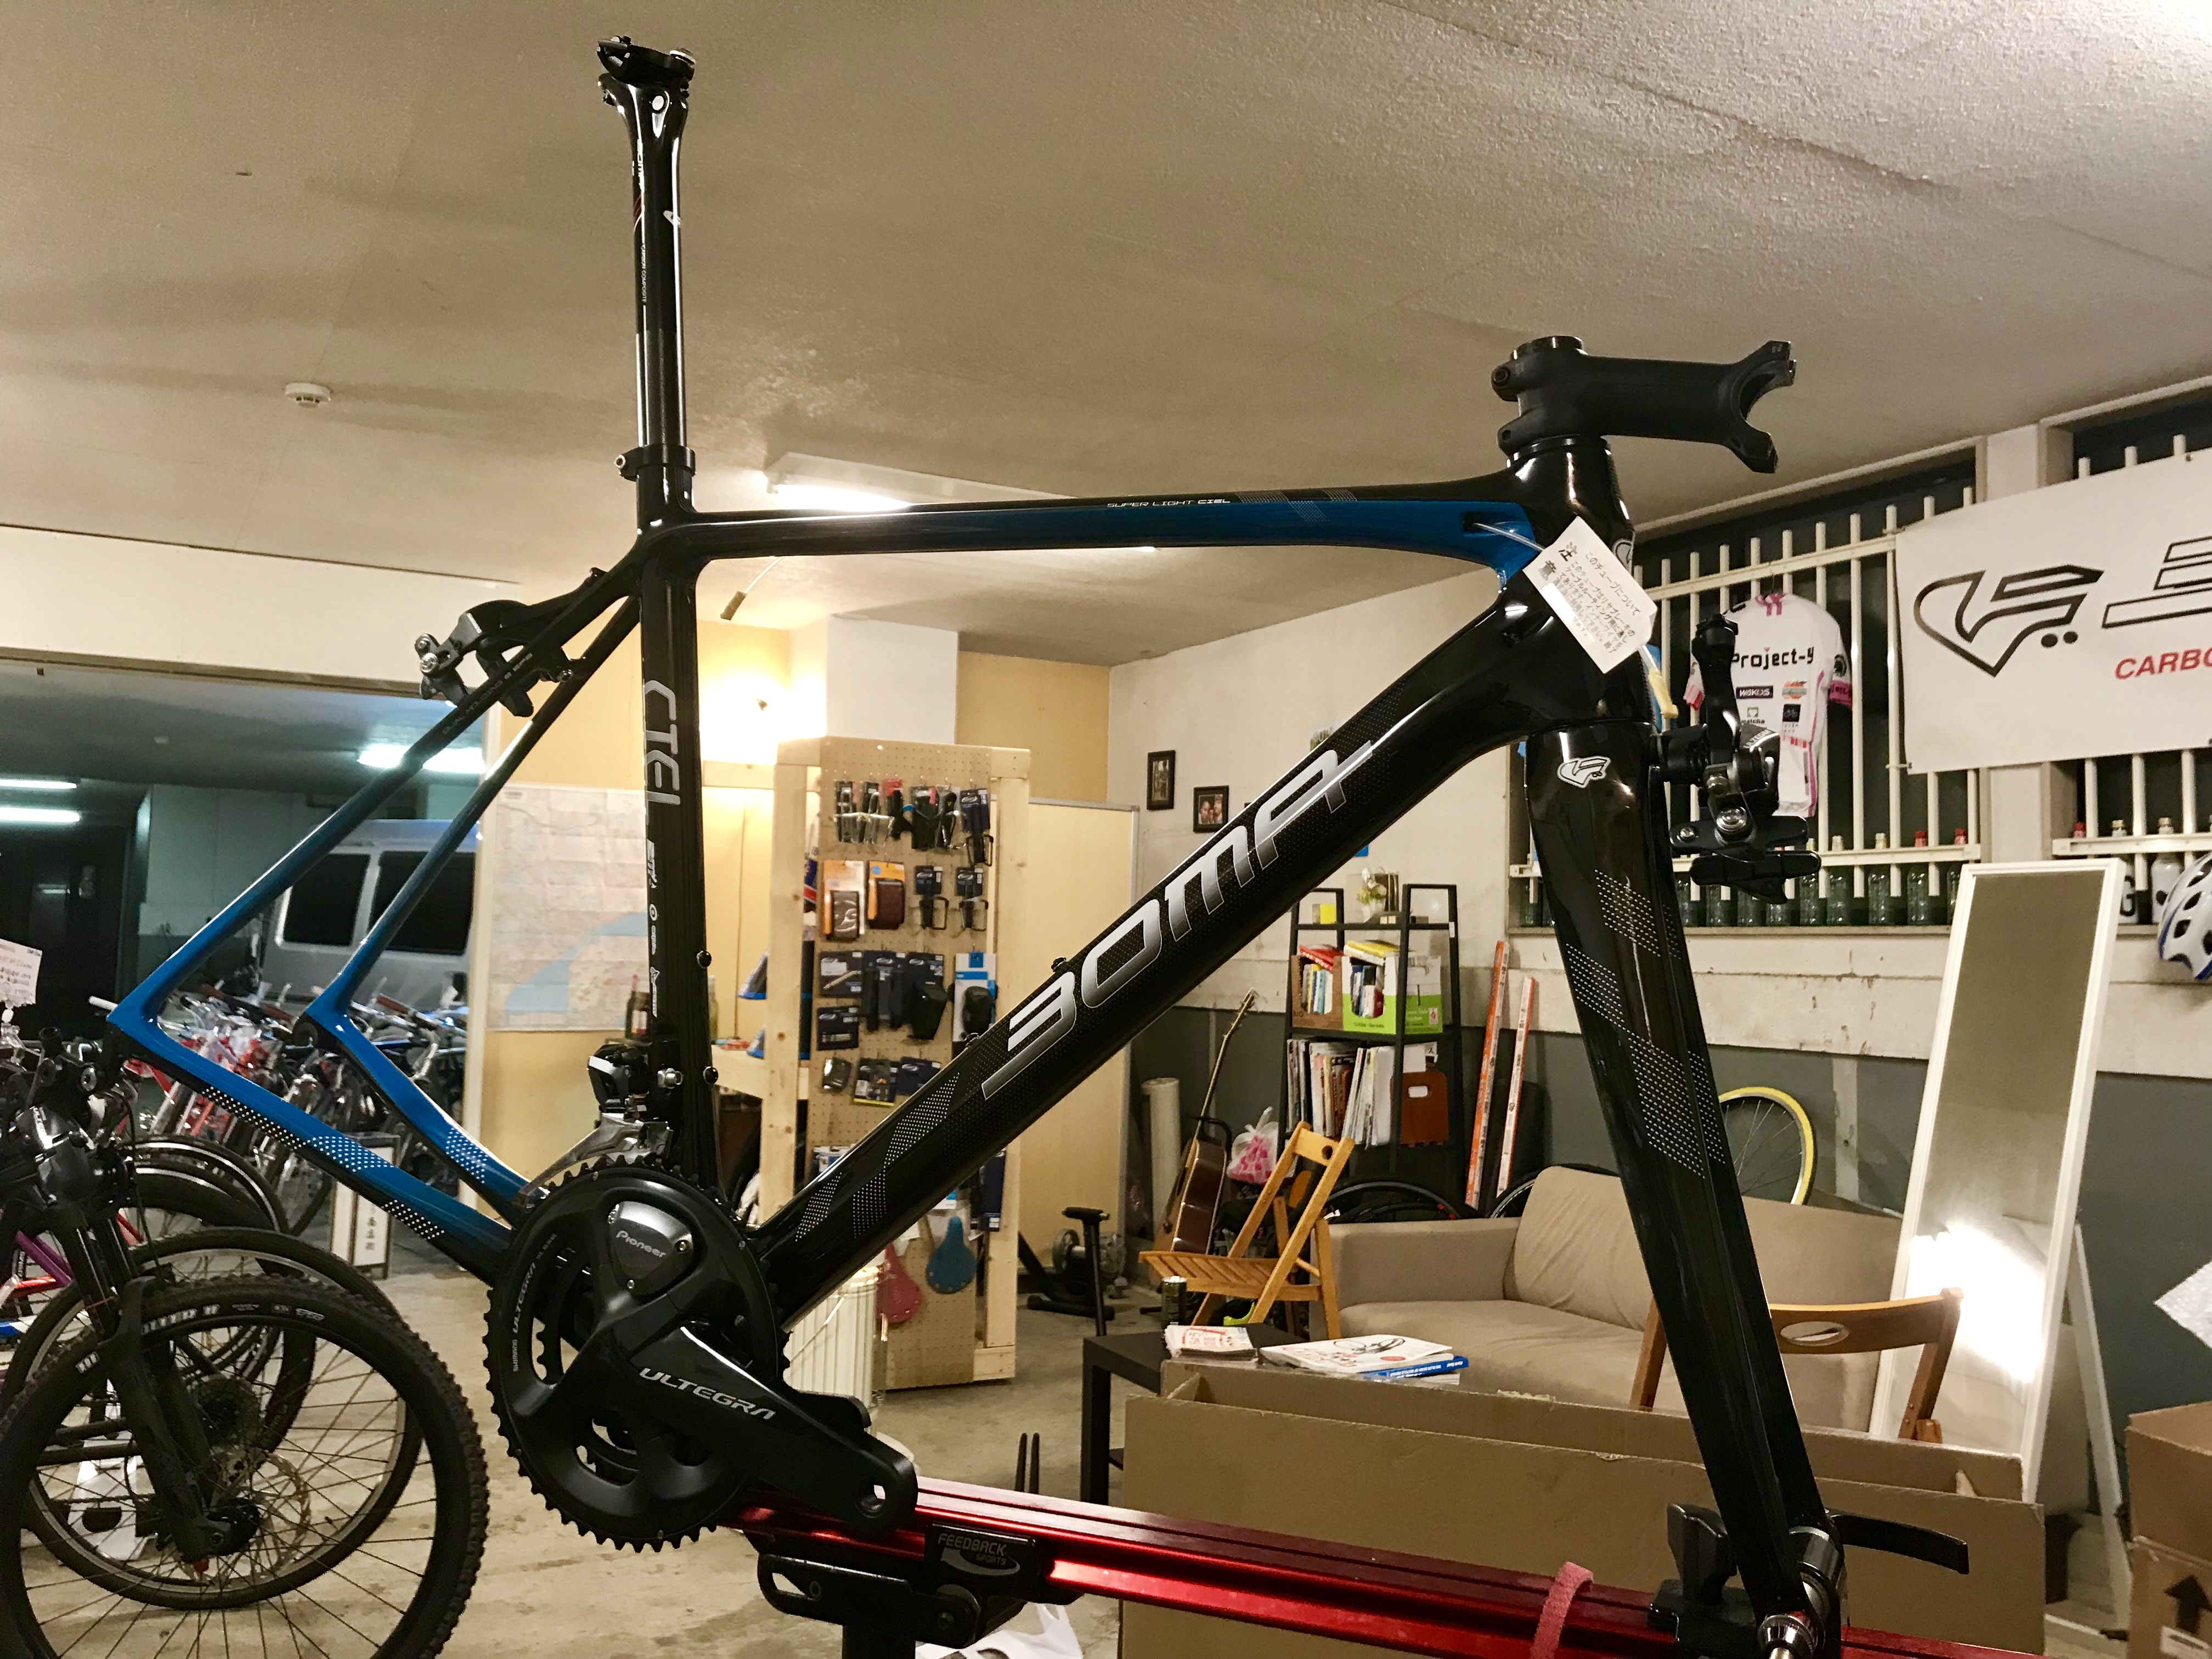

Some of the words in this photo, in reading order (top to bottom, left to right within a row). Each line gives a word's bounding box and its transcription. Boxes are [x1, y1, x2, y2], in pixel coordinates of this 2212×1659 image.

[466, 680, 503, 714] MOLDING
[616, 1229, 667, 1259] Pioneer
[637, 1367, 776, 1420] ULTEGRA
[938, 1532, 1005, 1556] FEEDBACK
[976, 1553, 1007, 1566] SPORTS
